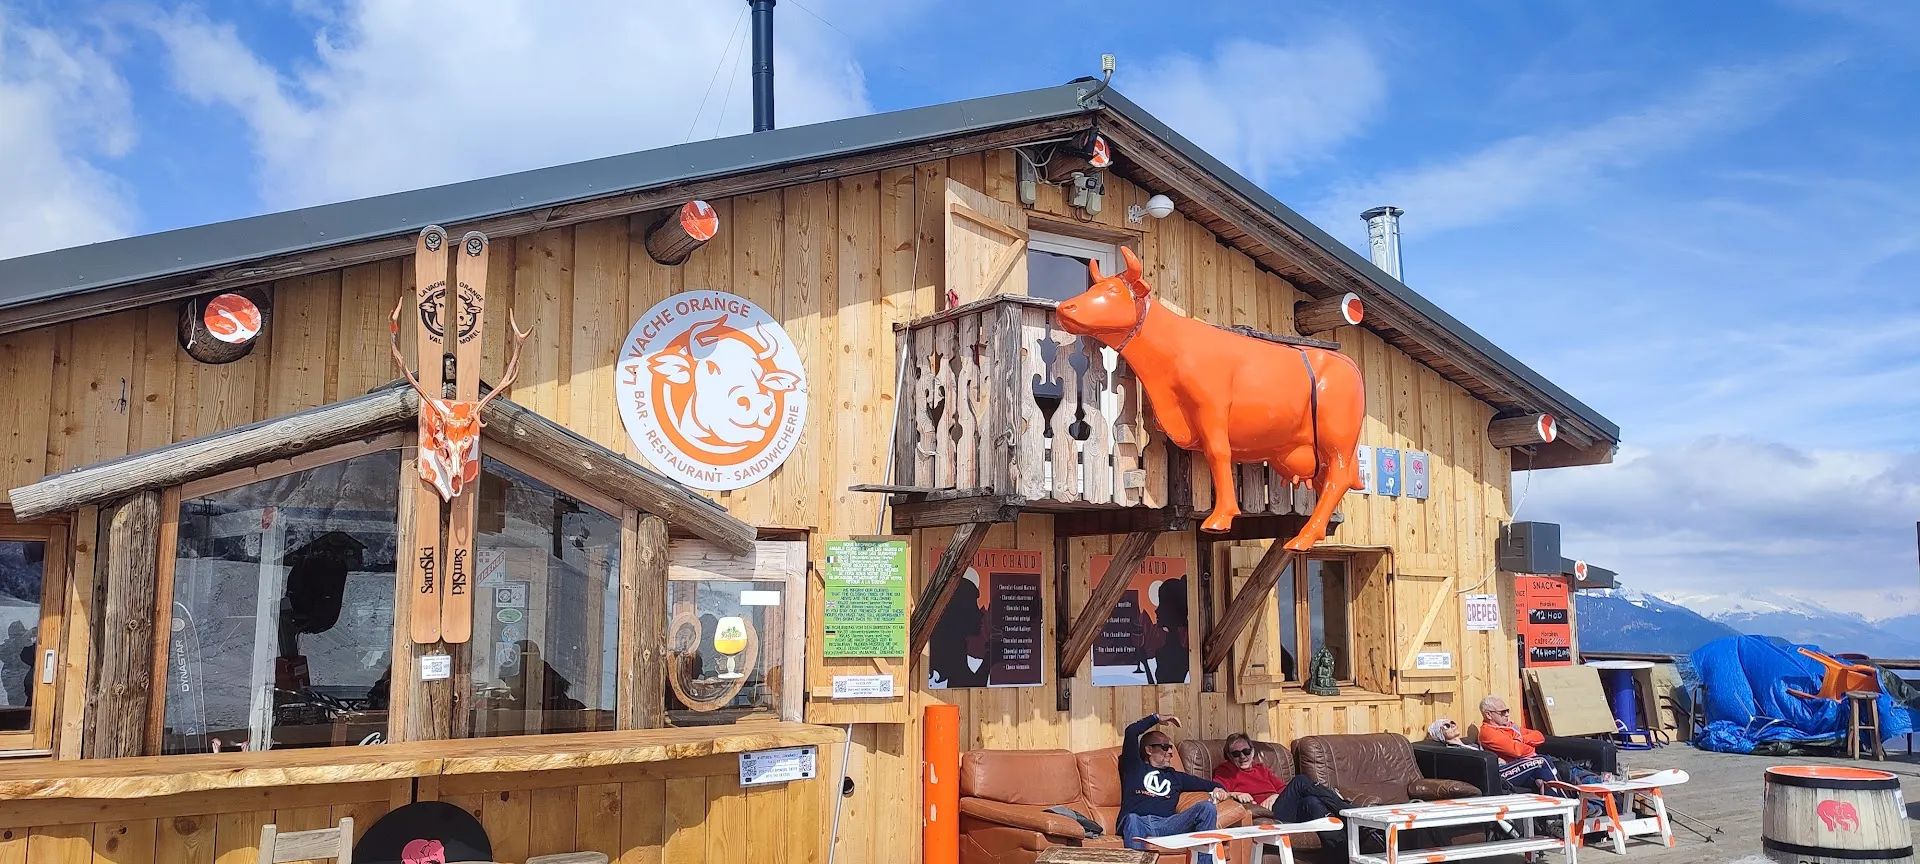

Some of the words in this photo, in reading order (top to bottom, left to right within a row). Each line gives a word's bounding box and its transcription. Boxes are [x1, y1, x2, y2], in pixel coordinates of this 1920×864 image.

[458, 282, 484, 302] ORANGE
[675, 297, 751, 318] ORANGE
[429, 334, 442, 344] VAL
[458, 330, 480, 346] MOREL
[628, 308, 674, 360] VACHE
[622, 364, 640, 386] LA
[634, 390, 648, 420] BAR
[646, 429, 723, 483] RESTAURANT
[734, 404, 800, 482] SANDWICHERIE
[420, 546, 434, 594] SamSki
[452, 548, 467, 596] SamSki
[1002, 554, 1036, 569] CHAUD
[1140, 562, 1167, 574] HAUD
[1532, 582, 1554, 590] SNACK
[1467, 604, 1497, 622] CREPES
[176, 640, 189, 692] DYNASTAR
